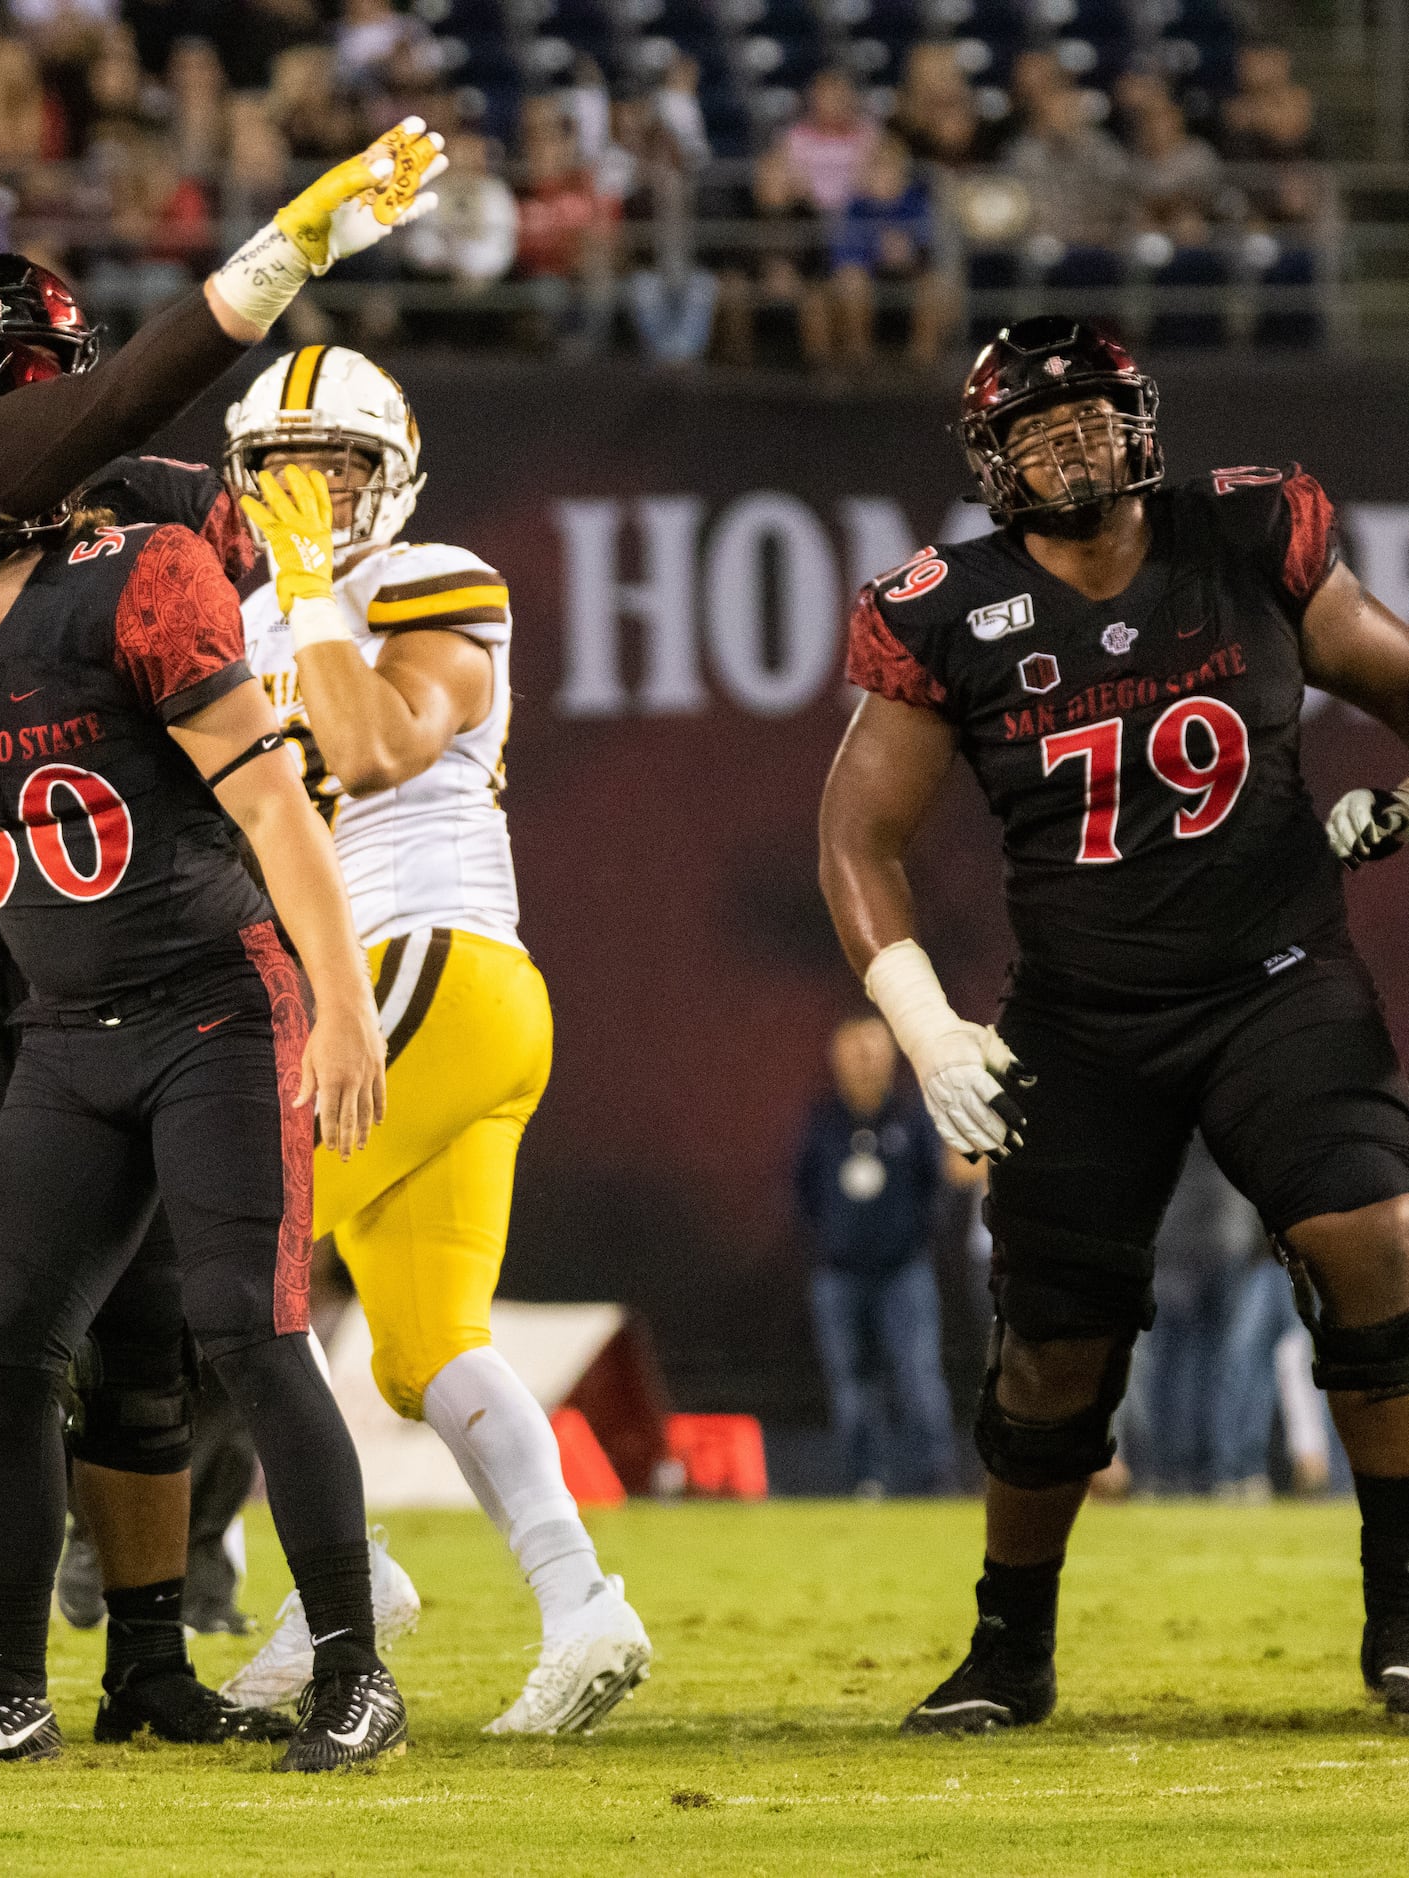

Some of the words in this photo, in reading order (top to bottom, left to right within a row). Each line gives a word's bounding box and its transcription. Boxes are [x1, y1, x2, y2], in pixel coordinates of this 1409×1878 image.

[967, 592, 1035, 641] 150
[18, 712, 106, 760] STATE
[1002, 704, 1055, 740] SAN
[1067, 677, 1157, 722] DIEGO
[1041, 695, 1250, 864] 79
